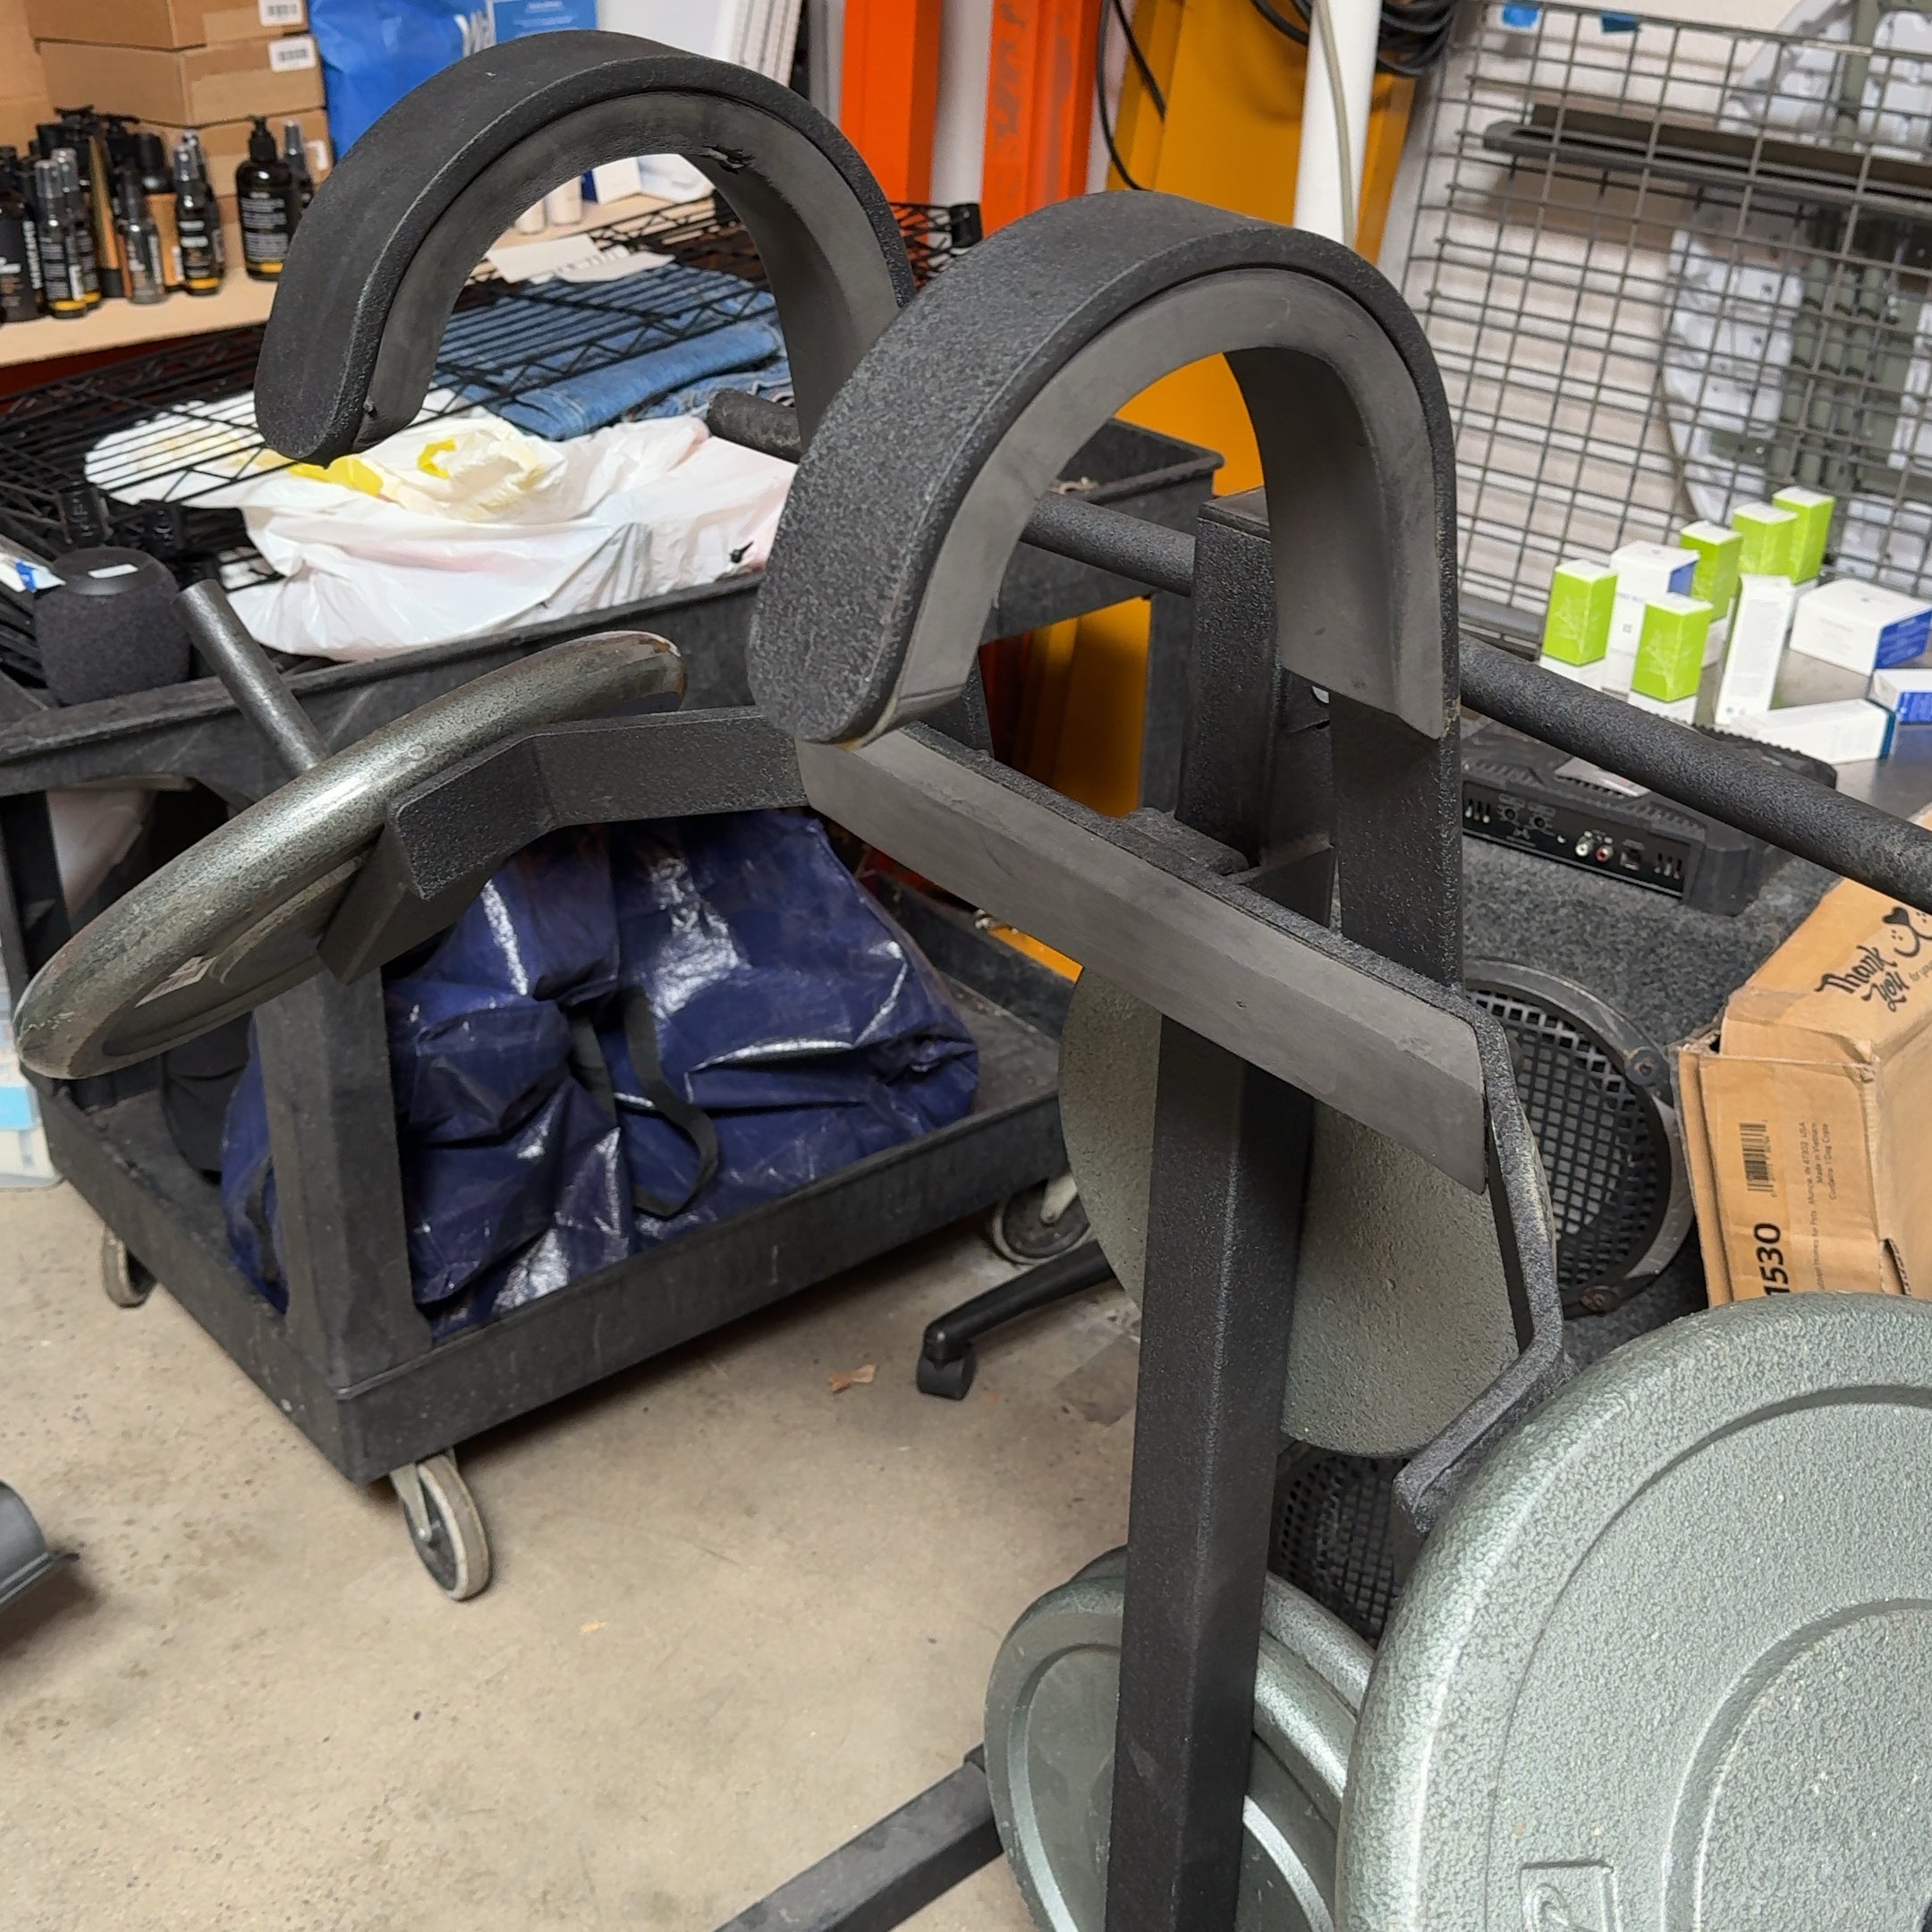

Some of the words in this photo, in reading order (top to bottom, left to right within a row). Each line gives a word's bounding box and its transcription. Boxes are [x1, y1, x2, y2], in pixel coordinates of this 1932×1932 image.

[1813, 945, 1898, 994] Thank
[1822, 1123, 1830, 1143] Crate
[1754, 1223, 1791, 1296] 1530
